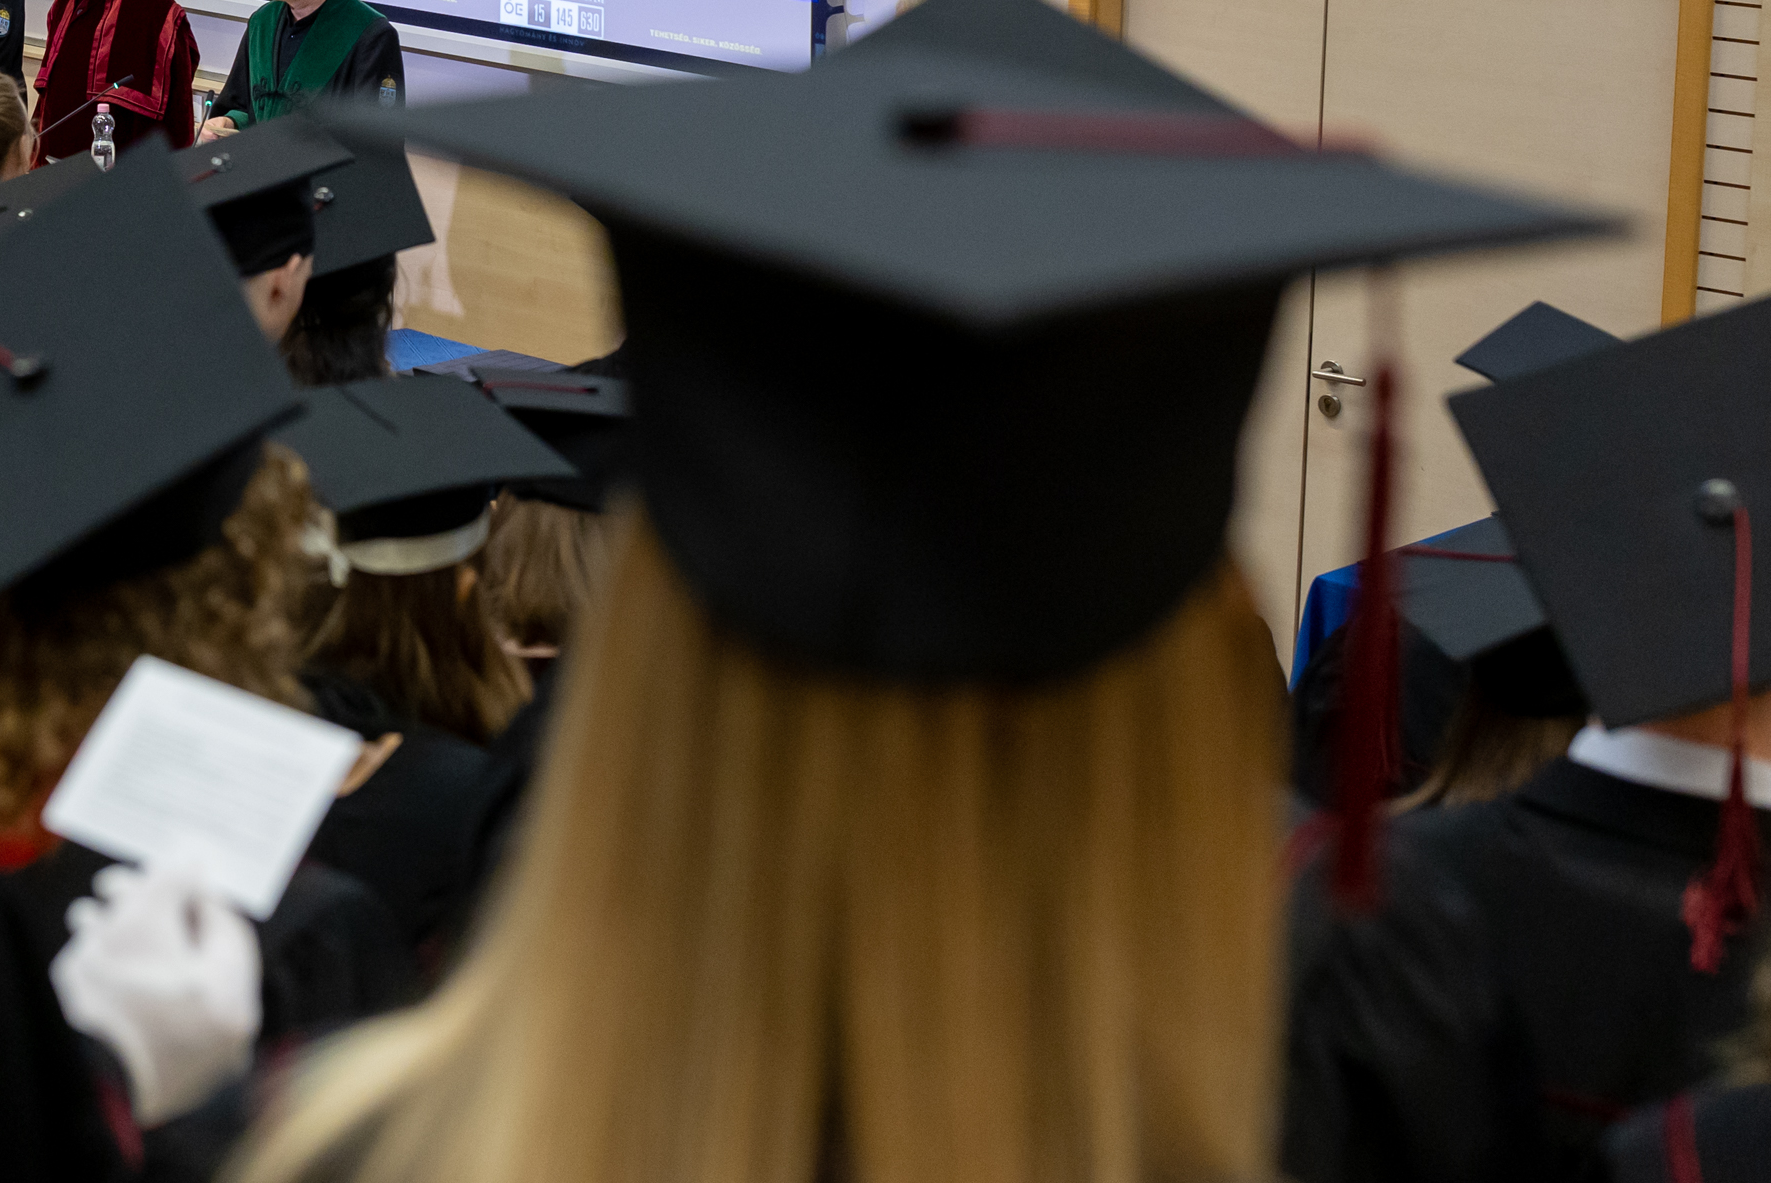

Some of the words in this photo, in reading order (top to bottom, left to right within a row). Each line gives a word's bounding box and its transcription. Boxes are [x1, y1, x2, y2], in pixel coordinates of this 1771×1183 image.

[534, 3, 545, 23] 15
[556, 7, 573, 28] 145
[580, 11, 600, 32] 630
